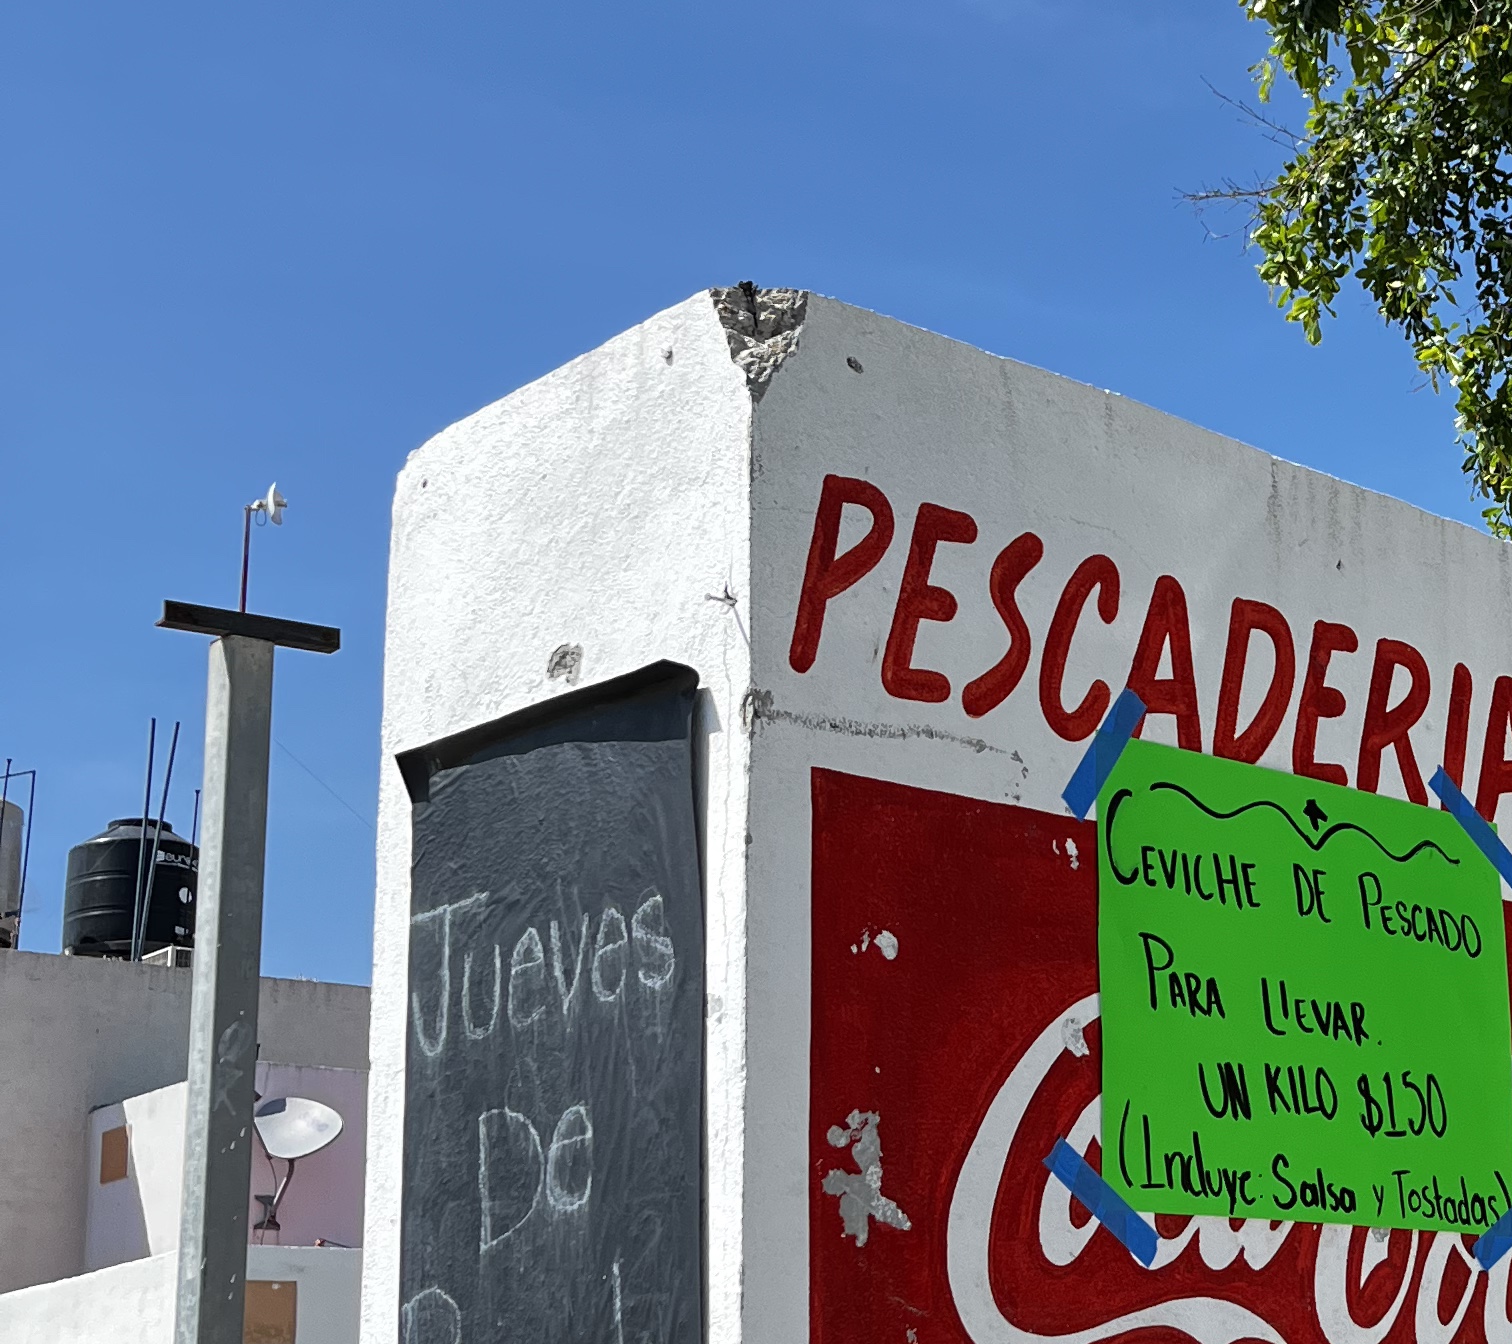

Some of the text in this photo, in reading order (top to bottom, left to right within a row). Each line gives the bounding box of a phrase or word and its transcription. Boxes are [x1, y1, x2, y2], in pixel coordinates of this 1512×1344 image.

[1106, 789, 1482, 958] CEVICHE DE PESCADO
[411, 889, 675, 1056] Jueves
[1138, 932, 1225, 1019] PARA
[1198, 1062, 1448, 1138] UN KILO $150
[478, 1101, 593, 1255] De
[1272, 1154, 1356, 1211] Salsa
[1373, 1183, 1385, 1217] y
